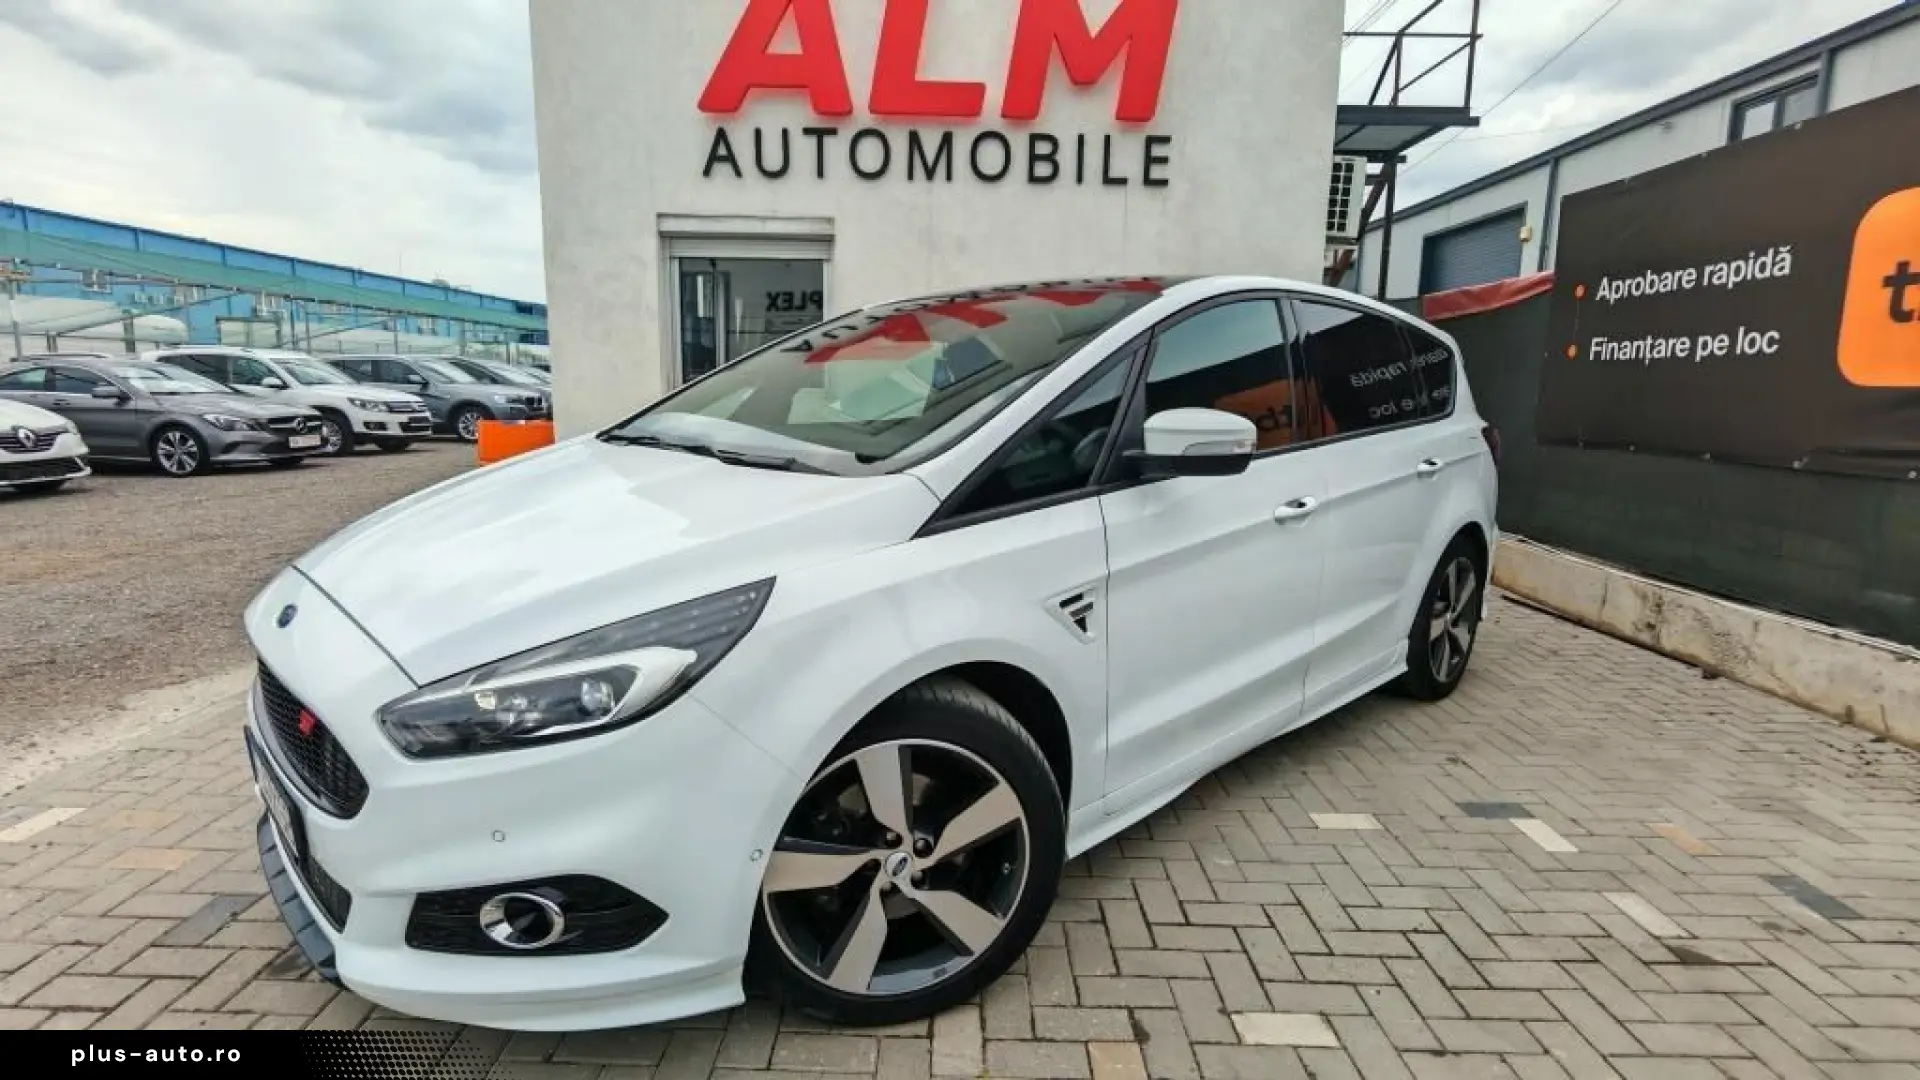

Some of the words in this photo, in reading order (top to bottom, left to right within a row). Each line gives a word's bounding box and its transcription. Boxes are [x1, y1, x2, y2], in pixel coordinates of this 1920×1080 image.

[698, 0, 1177, 121] ALM
[703, 128, 1172, 187] AUTOMOBILE
[1596, 269, 1697, 304] Aprobare
[1703, 245, 1792, 289] rapidă
[1882, 260, 1920, 323] t
[1590, 335, 1691, 365] Finanțare
[1695, 333, 1730, 362] pe
[1736, 326, 1780, 356] loc
